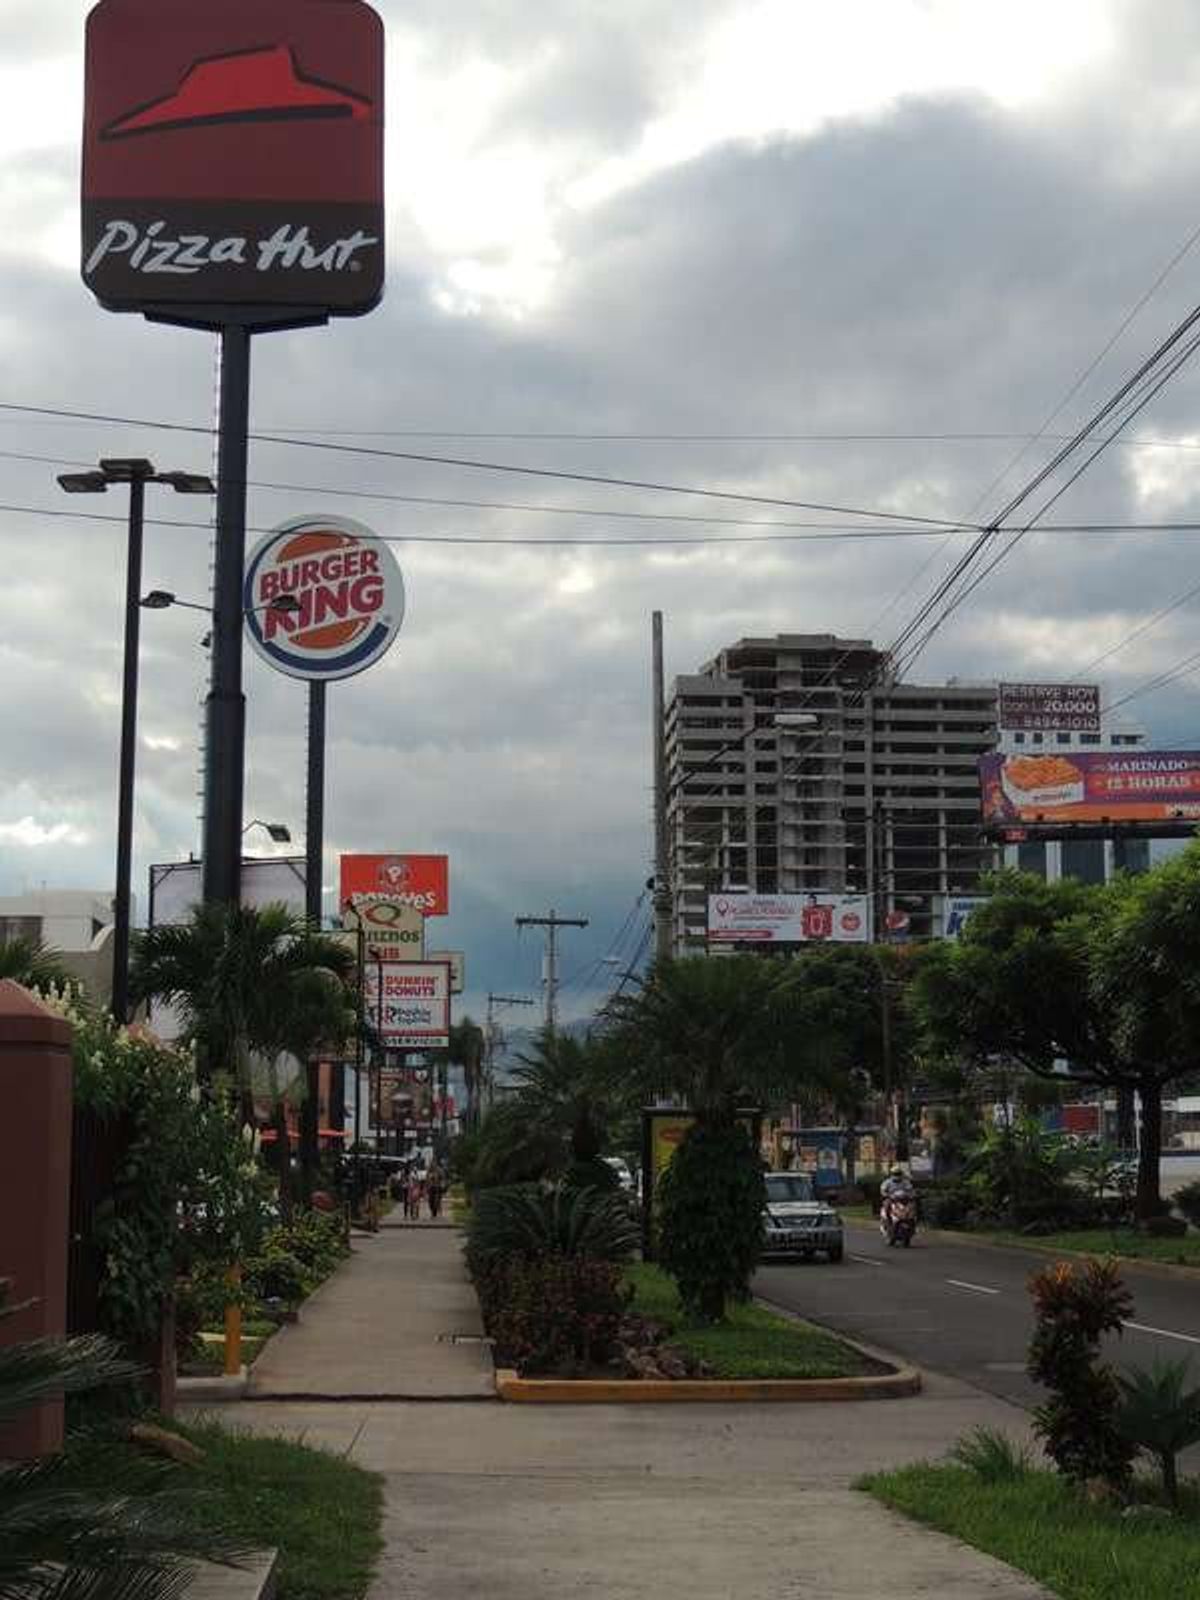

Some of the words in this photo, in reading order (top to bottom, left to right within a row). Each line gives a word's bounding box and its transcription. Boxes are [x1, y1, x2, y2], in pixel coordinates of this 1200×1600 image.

[84, 220, 247, 274] Pizza
[255, 223, 378, 271] Hut
[260, 549, 379, 602] BURGER
[263, 575, 384, 641] KING
[1107, 759, 1188, 772] MARINADO
